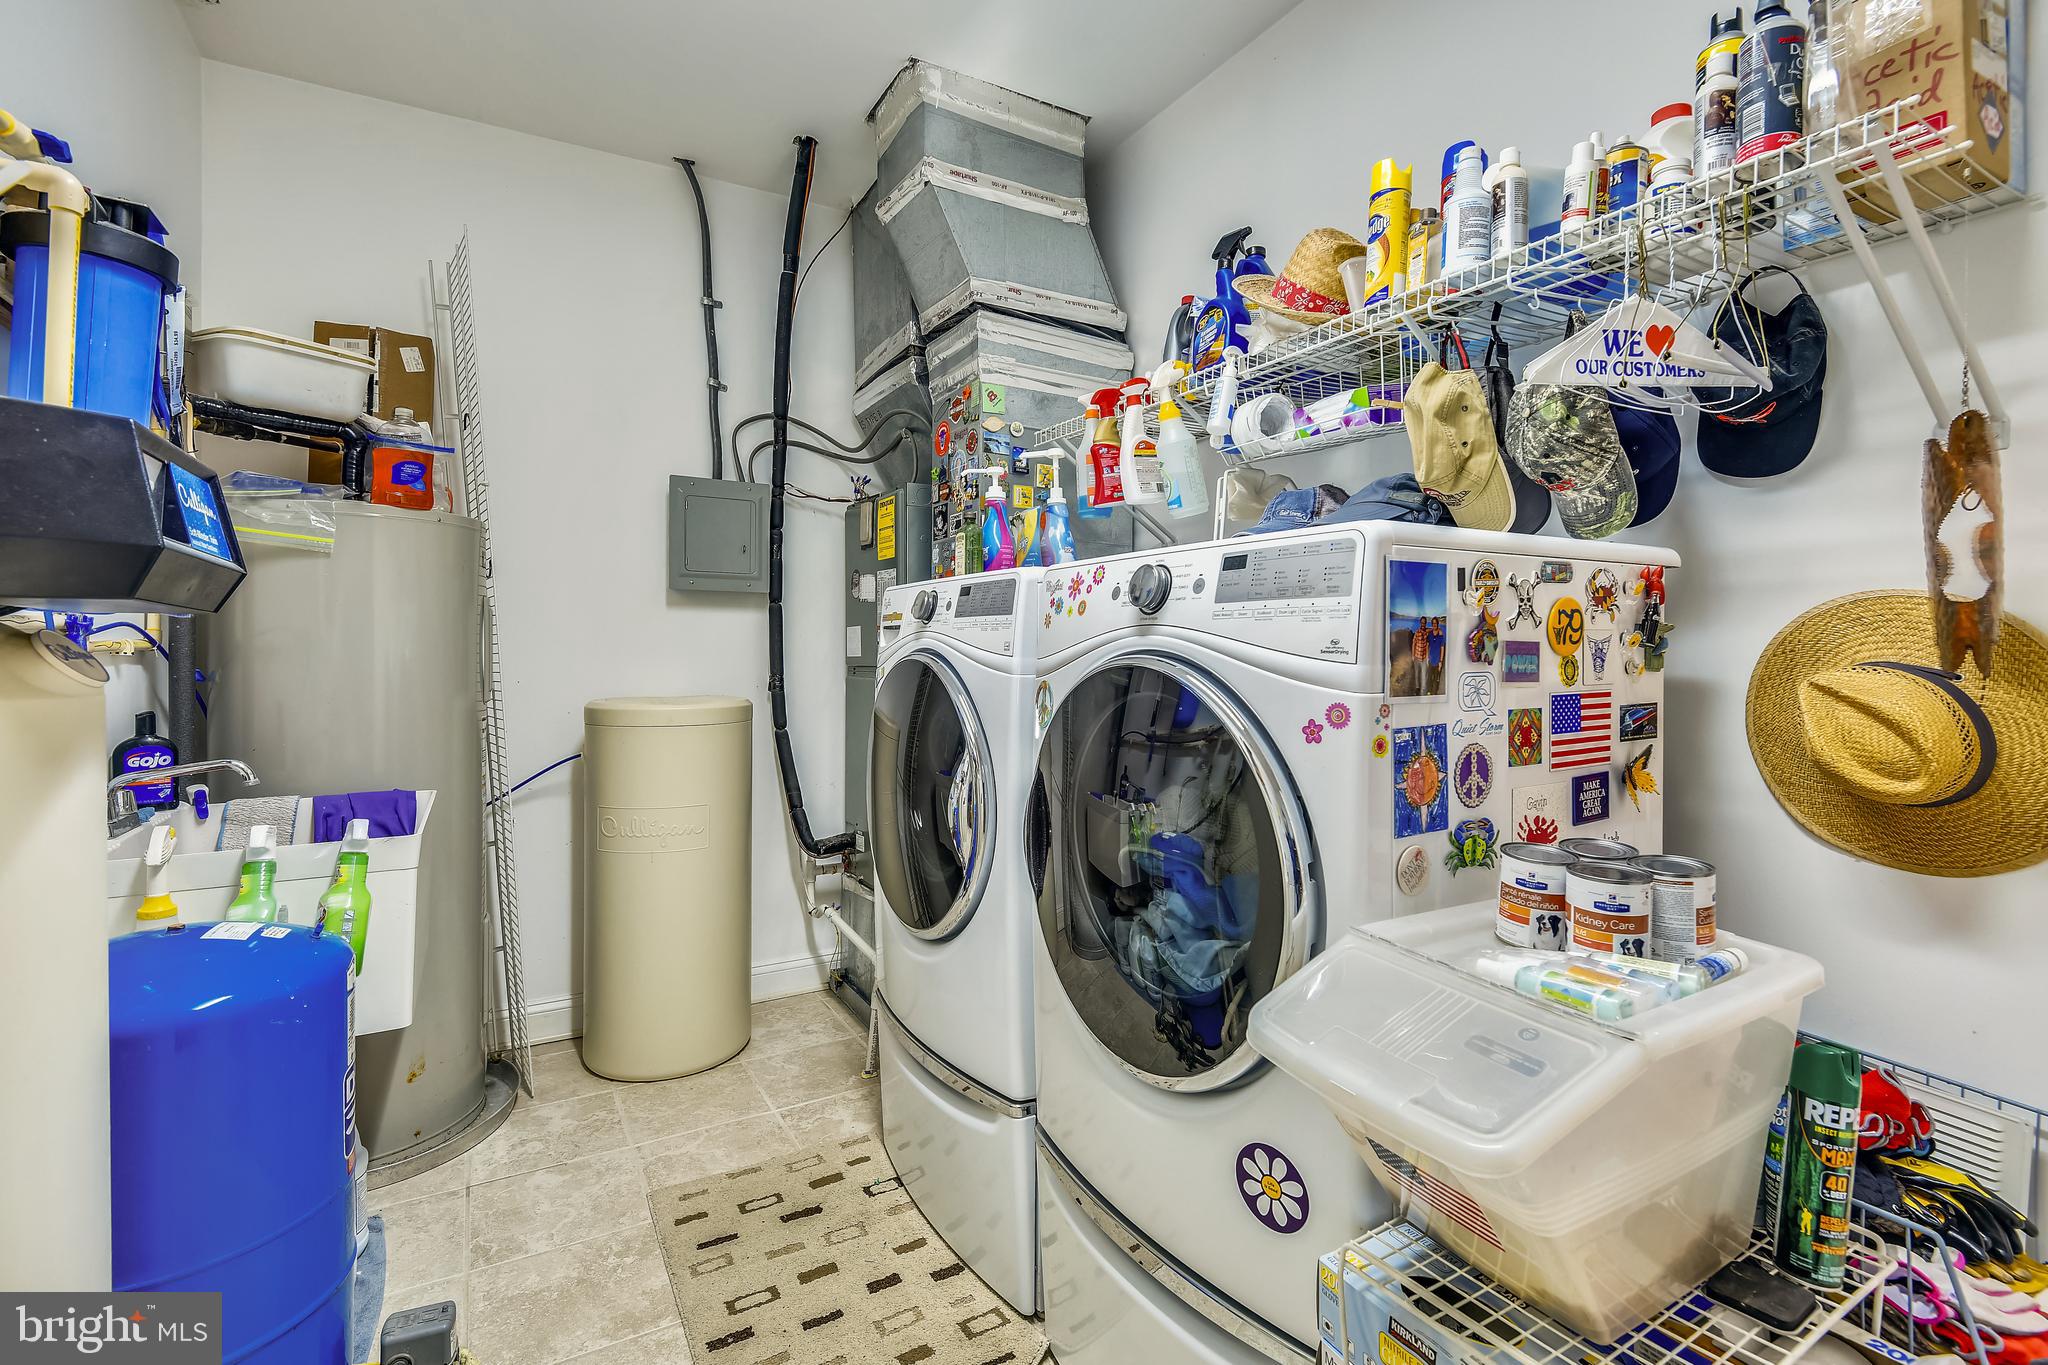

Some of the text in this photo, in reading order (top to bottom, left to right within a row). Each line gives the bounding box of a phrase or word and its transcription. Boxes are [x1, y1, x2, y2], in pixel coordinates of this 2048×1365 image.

[1863, 25, 1960, 87] cetic
[1006, 286, 1022, 296] Shur
[1602, 329, 1644, 357] WE
[1576, 359, 1706, 378] OUR CUSTOMERS
[178, 482, 217, 526] Culligan
[1452, 719, 1478, 738] Quiet
[127, 753, 172, 769] GOJO
[1579, 788, 1606, 801] AMERICA
[1583, 779, 1601, 791] MAKE
[1582, 798, 1601, 810] GREAT
[1582, 806, 1602, 818] AGAIN
[601, 814, 705, 849] Culligan
[1526, 900, 1539, 908] del
[1575, 912, 1636, 931] Kidney Care
[1821, 1147, 1856, 1167] MAX
[1825, 1175, 1848, 1192] 40
[1391, 1317, 1436, 1361] KIRKLAND
